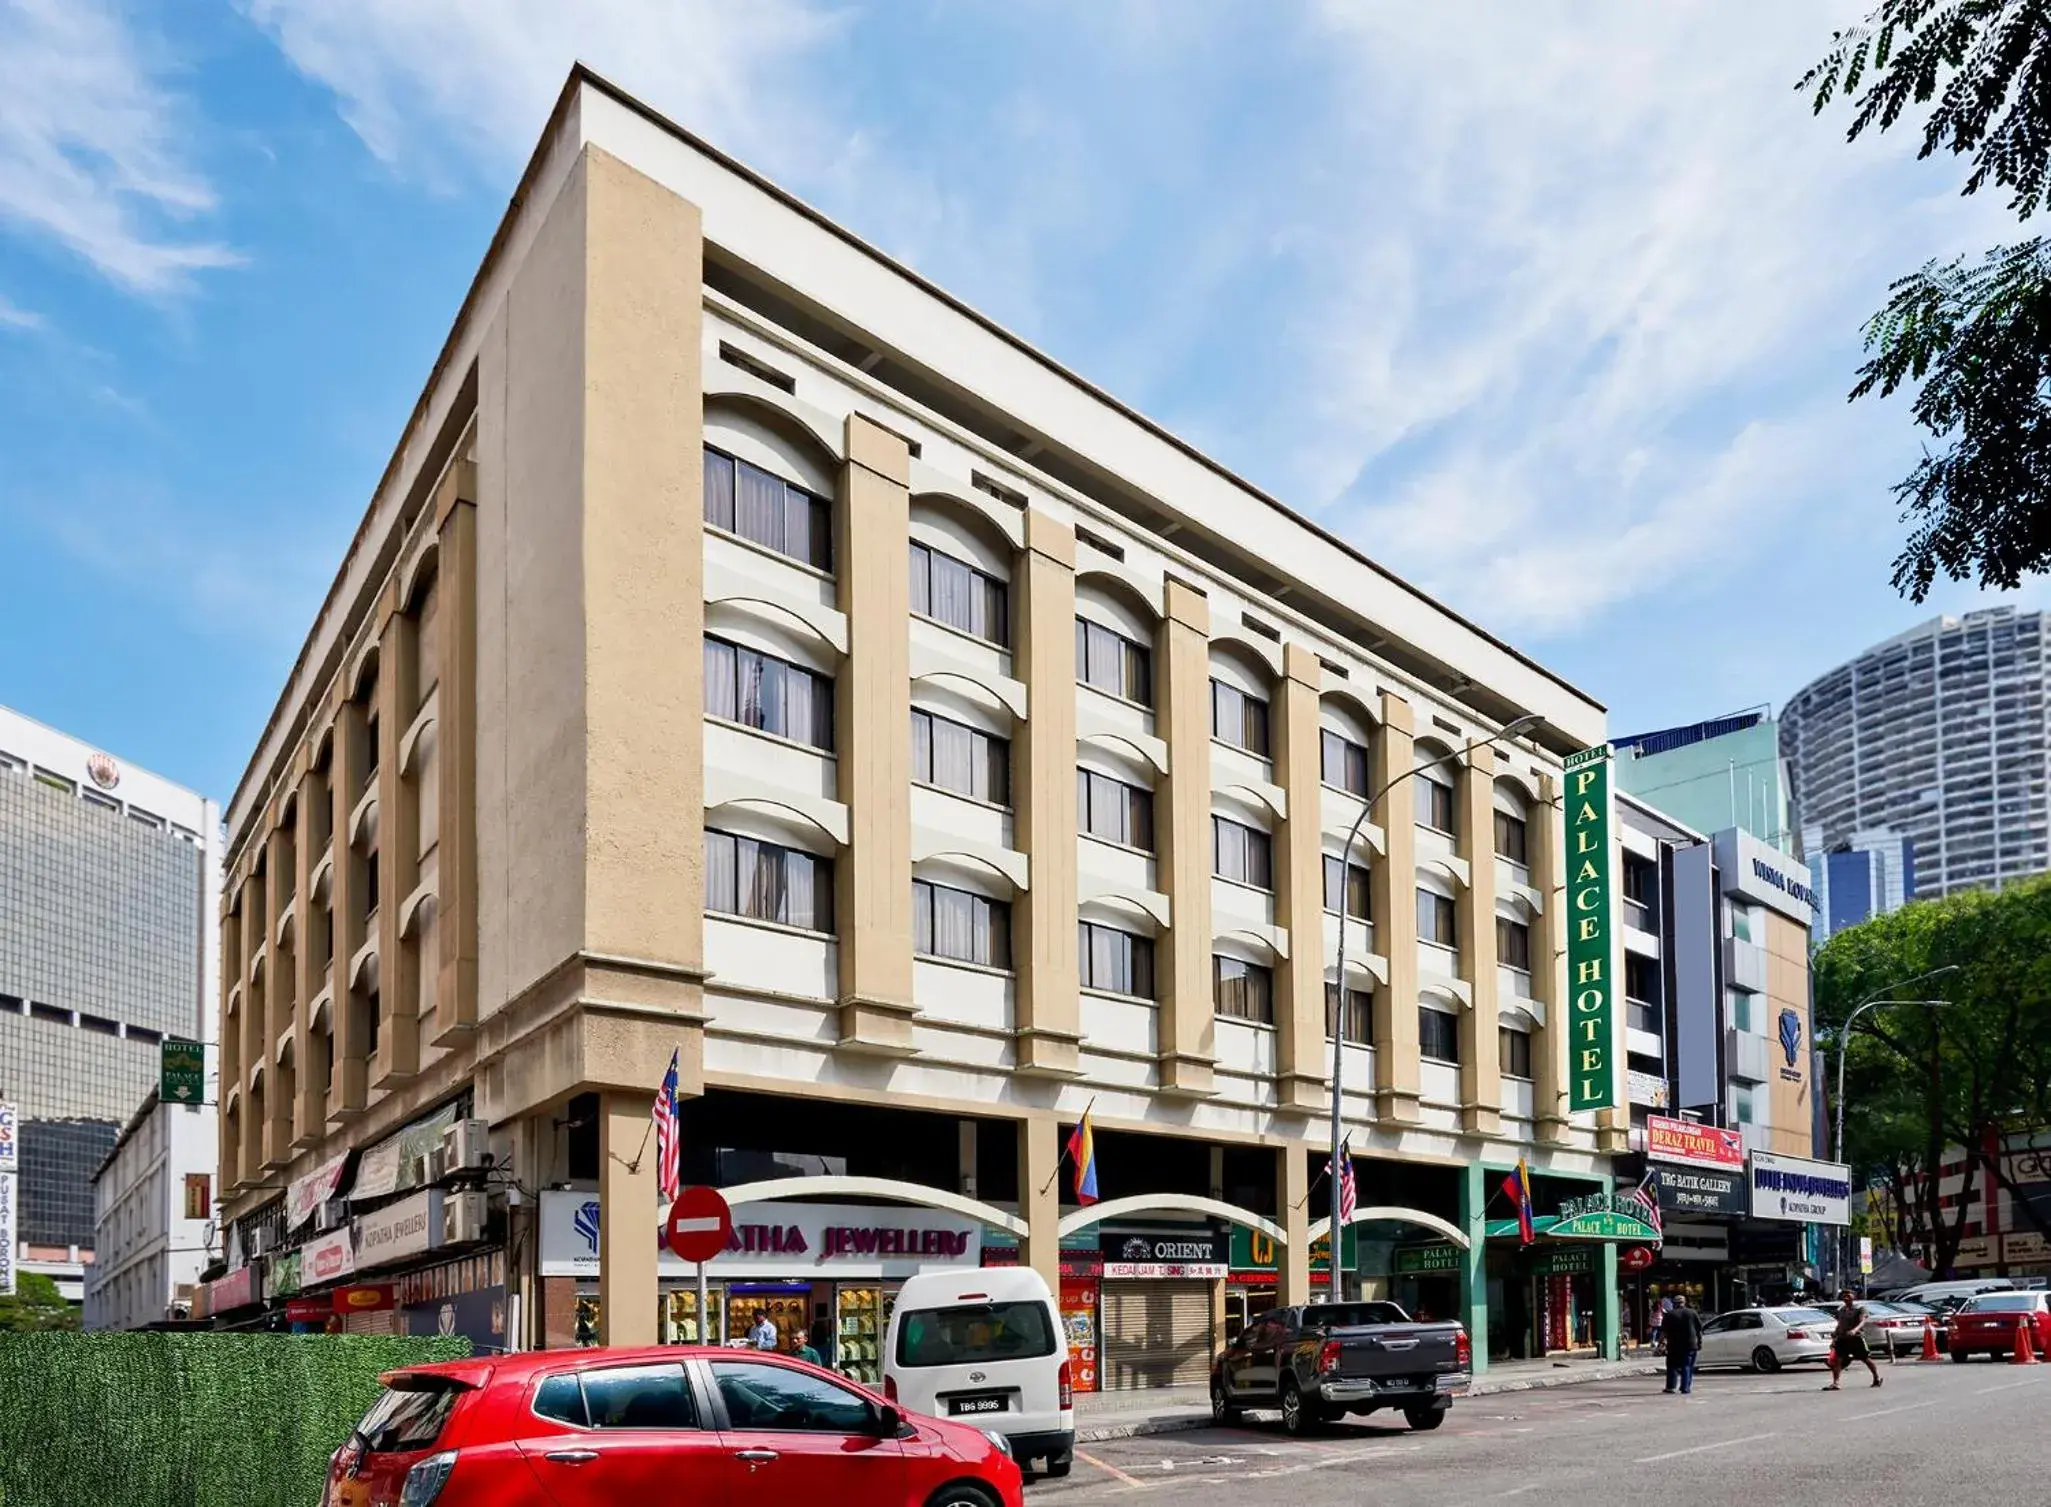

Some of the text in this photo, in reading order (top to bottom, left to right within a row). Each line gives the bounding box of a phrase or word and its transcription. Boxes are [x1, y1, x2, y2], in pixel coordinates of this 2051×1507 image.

[1567, 747, 1605, 767] HOTEL
[1576, 770, 1603, 1101] PALACE HOTEL
[164, 1043, 200, 1053] HOTEL
[1652, 1129, 1683, 1148] DERAZ
[1685, 1134, 1716, 1152] TRAVEL
[1700, 1177, 1731, 1193] GALLERY
[1559, 1192, 1611, 1220] PALACE
[1573, 1220, 1641, 1235] PALACE HOTEL
[819, 1226, 974, 1260] JEWELLERS
[1155, 1242, 1212, 1258] ORIENT
[1553, 1253, 1588, 1262] PALACE
[1553, 1262, 1589, 1272] HOTEL
